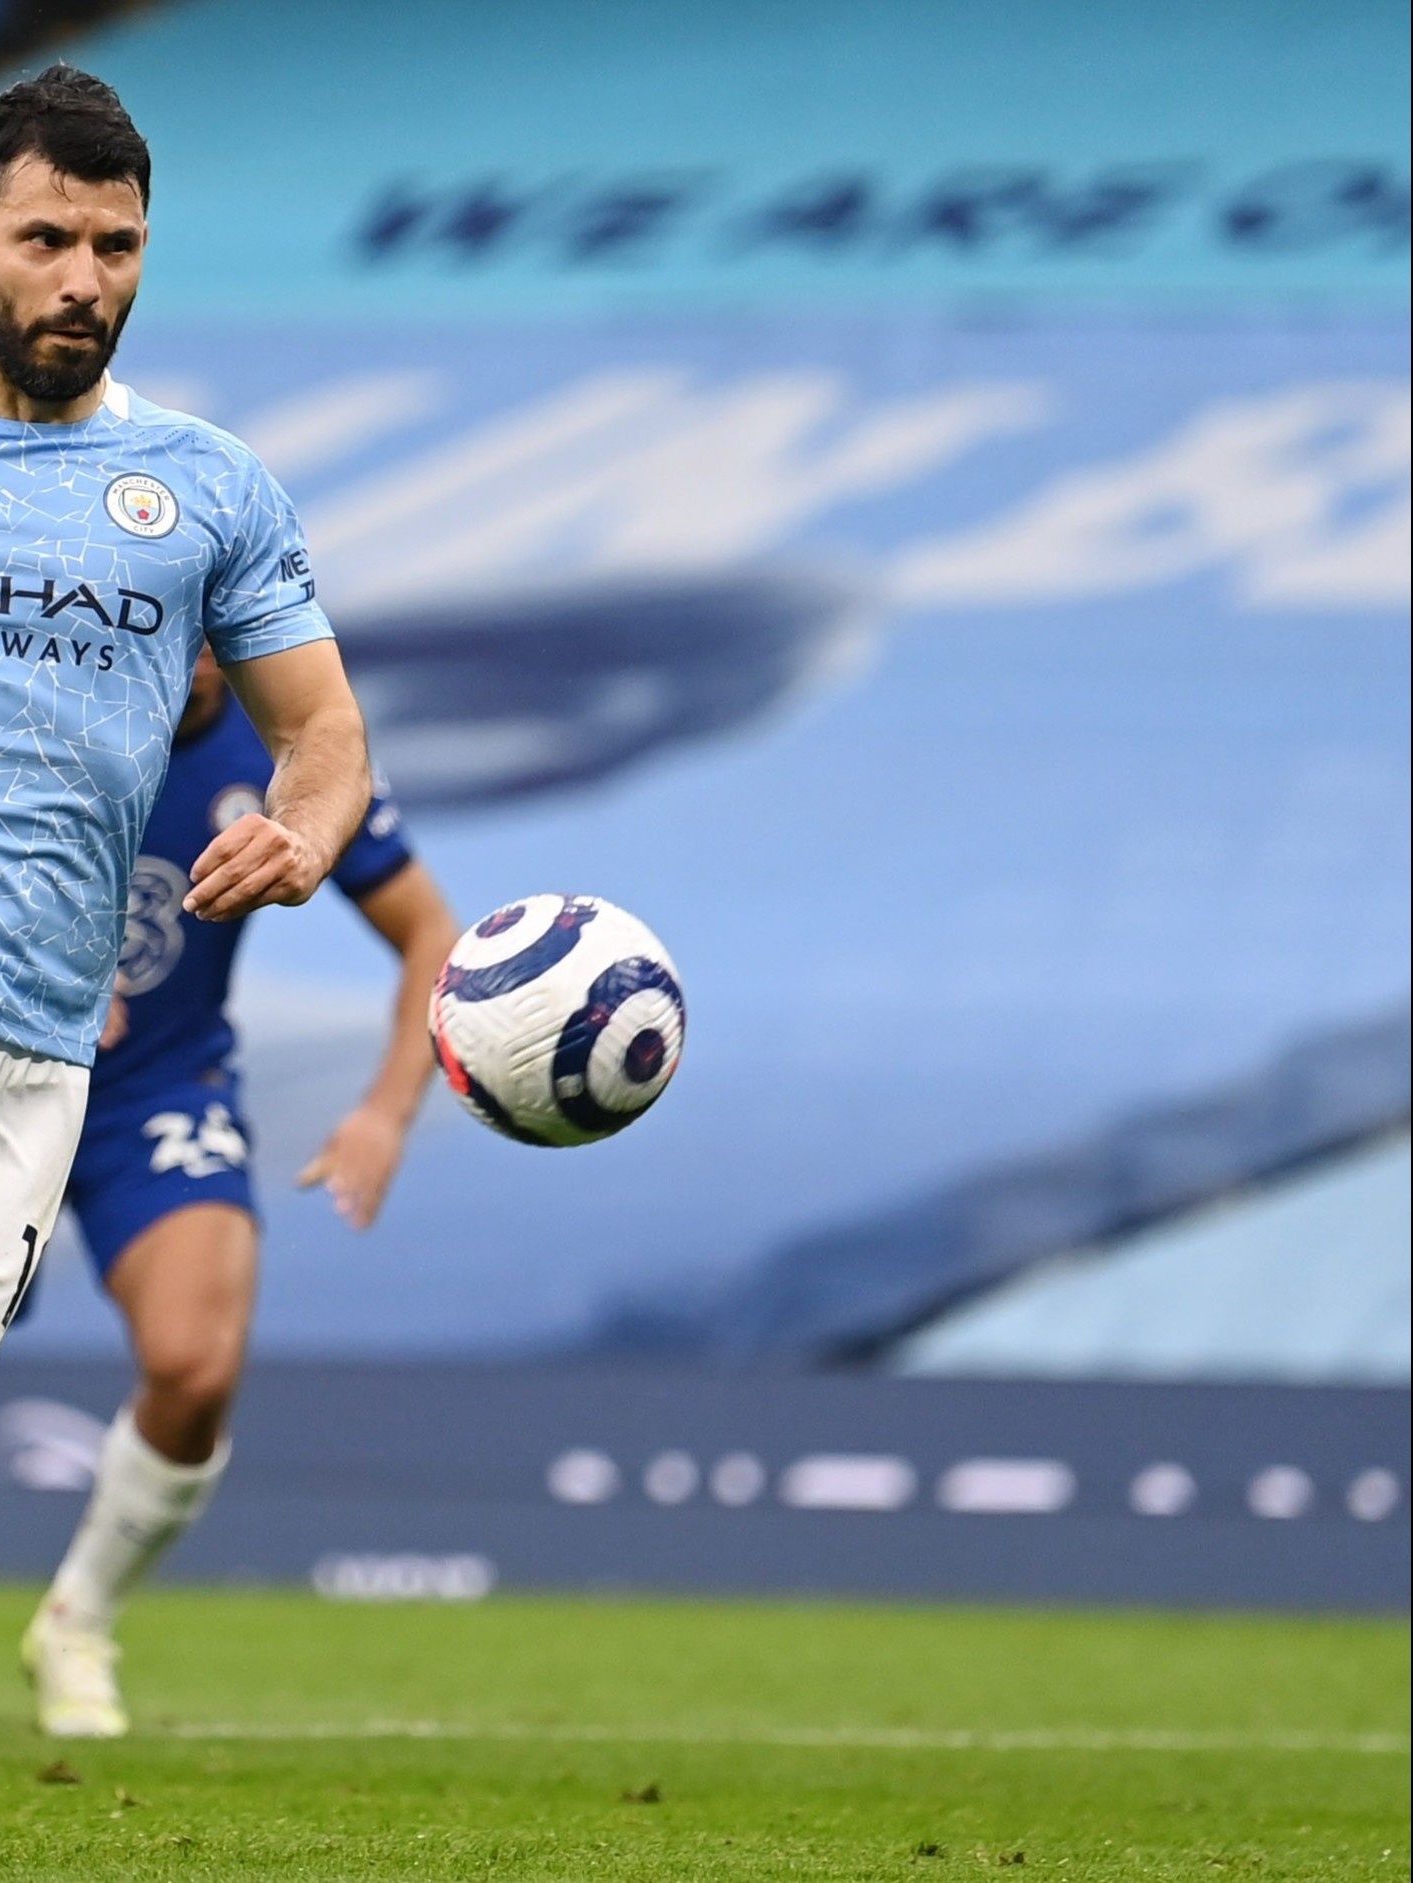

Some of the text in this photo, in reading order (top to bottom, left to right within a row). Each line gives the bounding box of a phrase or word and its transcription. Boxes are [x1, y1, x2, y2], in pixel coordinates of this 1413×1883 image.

[112, 478, 170, 501] MANCHESTER
[132, 525, 154, 534] CITY
[279, 547, 311, 583] NE
